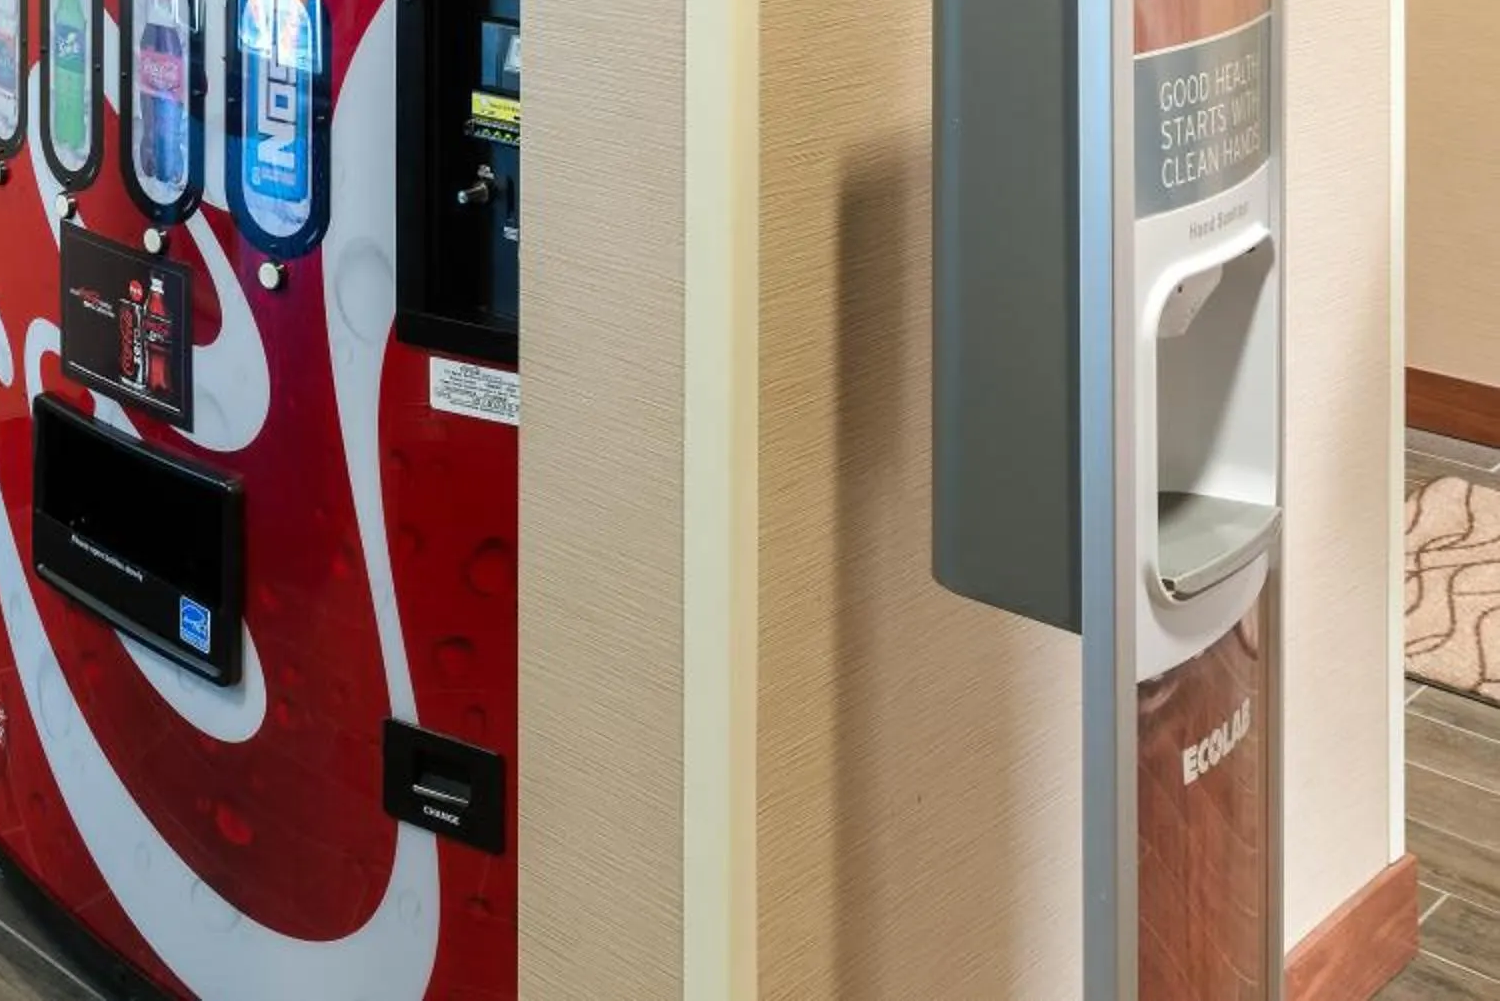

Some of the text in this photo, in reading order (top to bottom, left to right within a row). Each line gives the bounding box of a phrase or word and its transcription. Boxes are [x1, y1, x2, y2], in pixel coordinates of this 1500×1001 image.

[1160, 72, 1209, 112] GOOD
[1161, 89, 1261, 151] STARTS WITH
[1161, 122, 1261, 189] CLEAN HANDS
[1182, 696, 1250, 787] ECOLAB
